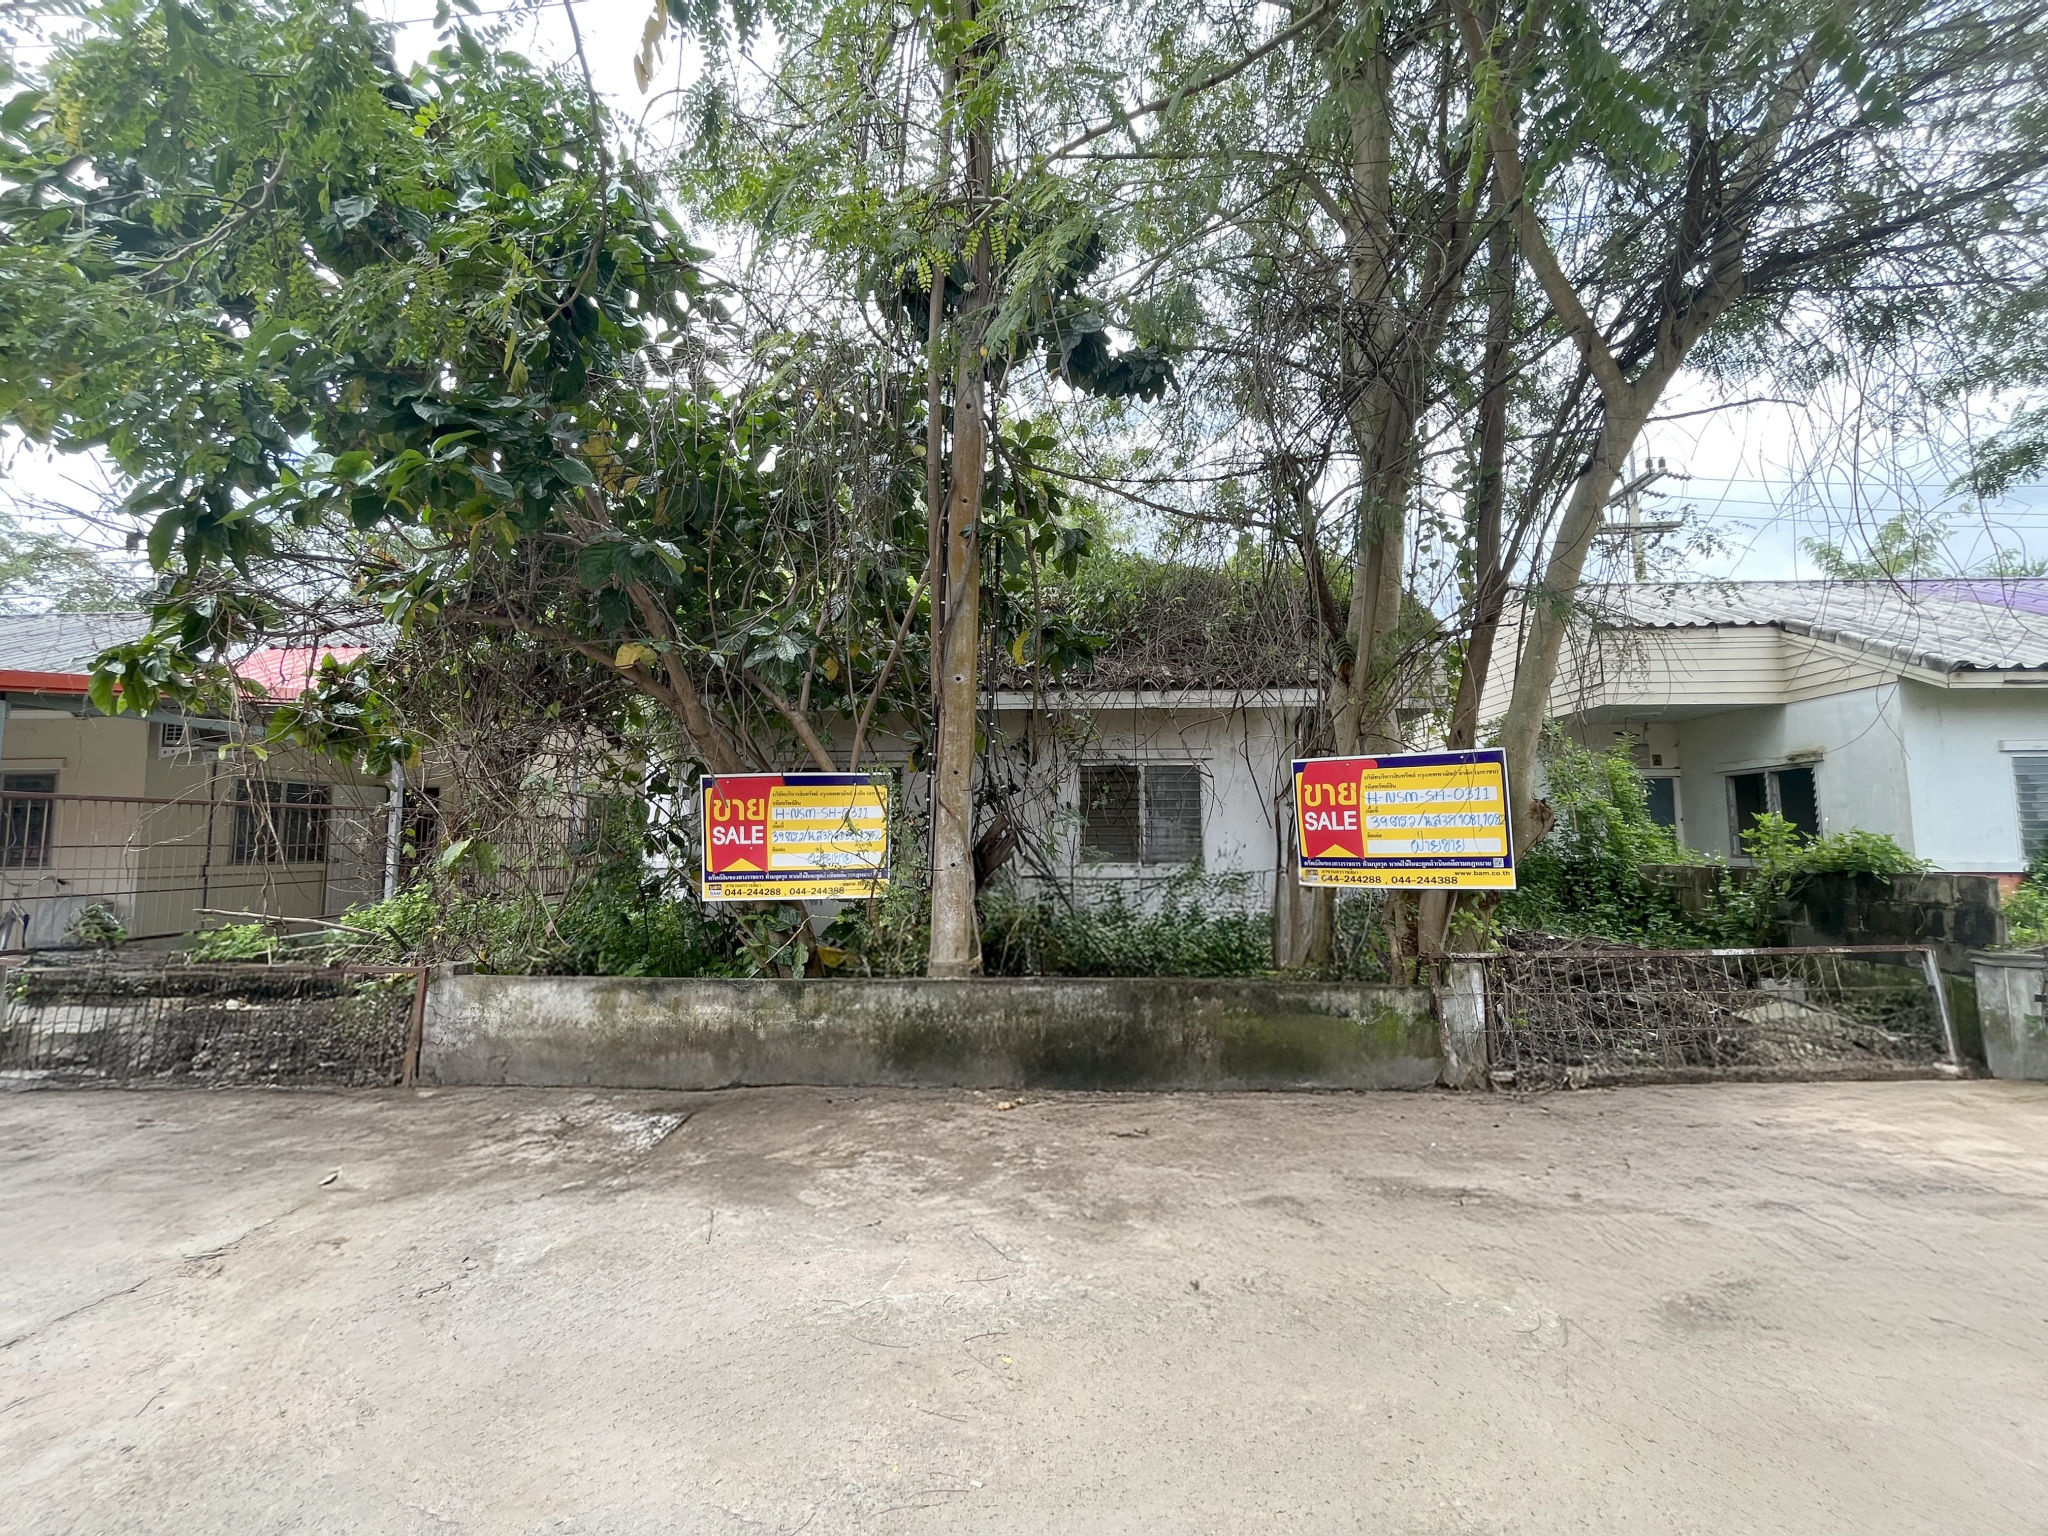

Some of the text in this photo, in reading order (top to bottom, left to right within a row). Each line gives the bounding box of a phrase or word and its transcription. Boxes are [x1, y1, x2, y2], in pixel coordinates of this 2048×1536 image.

[1304, 782, 1357, 807] ขาย
[714, 798, 765, 821] ขาย
[1304, 810, 1357, 831] SALE
[712, 825, 764, 845] SALE
[1321, 874, 1381, 883] 044-244288
[1391, 876, 1458, 884] 044-244388
[724, 888, 781, 896] 044-244288
[789, 887, 845, 896] 044-244388
